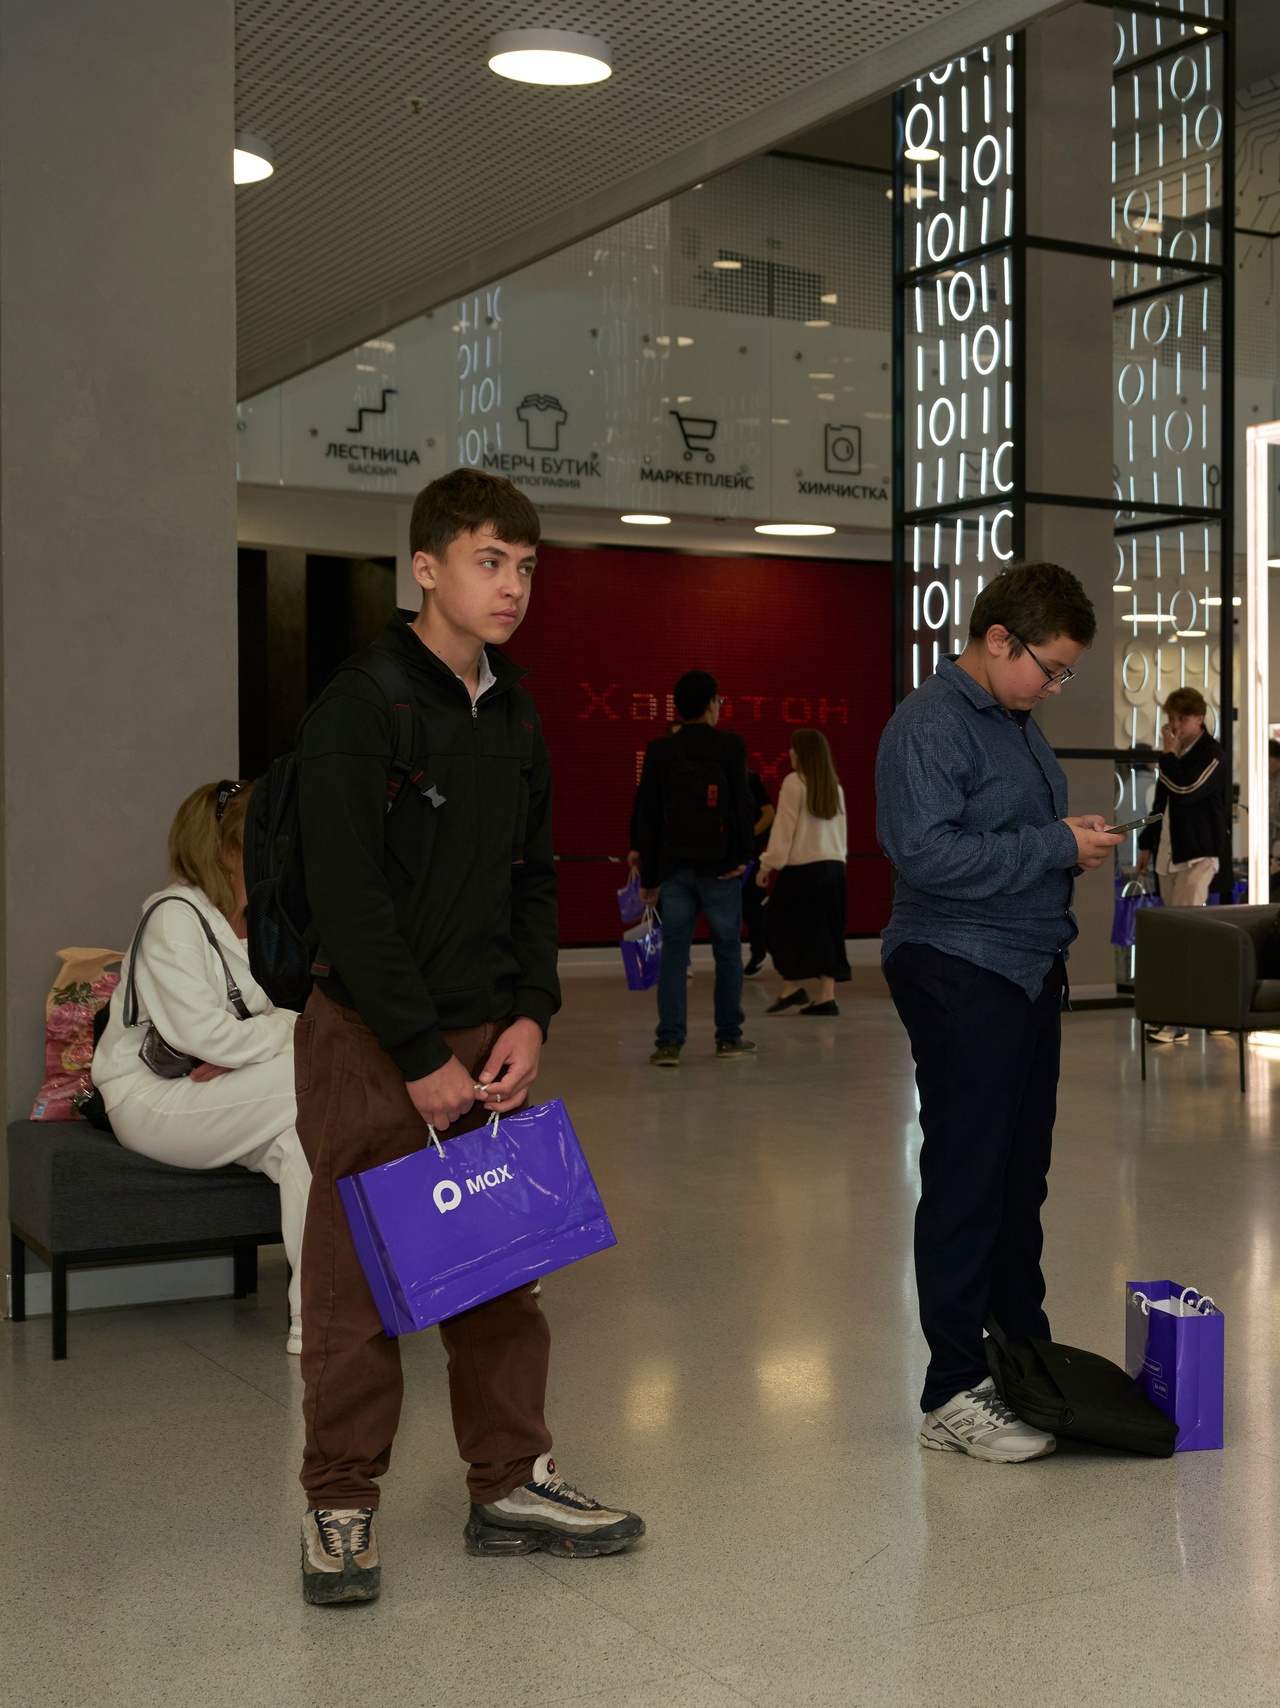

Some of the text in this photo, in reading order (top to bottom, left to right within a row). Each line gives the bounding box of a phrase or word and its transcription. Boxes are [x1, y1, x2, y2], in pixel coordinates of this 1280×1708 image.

[325, 442, 421, 465] ЛЕСТНИЦА
[483, 453, 601, 477] МЕРЧ БУТИК
[640, 467, 754, 491] МАРКЕТПЛЕЙС
[798, 481, 888, 501] ХИМЧИСТКА
